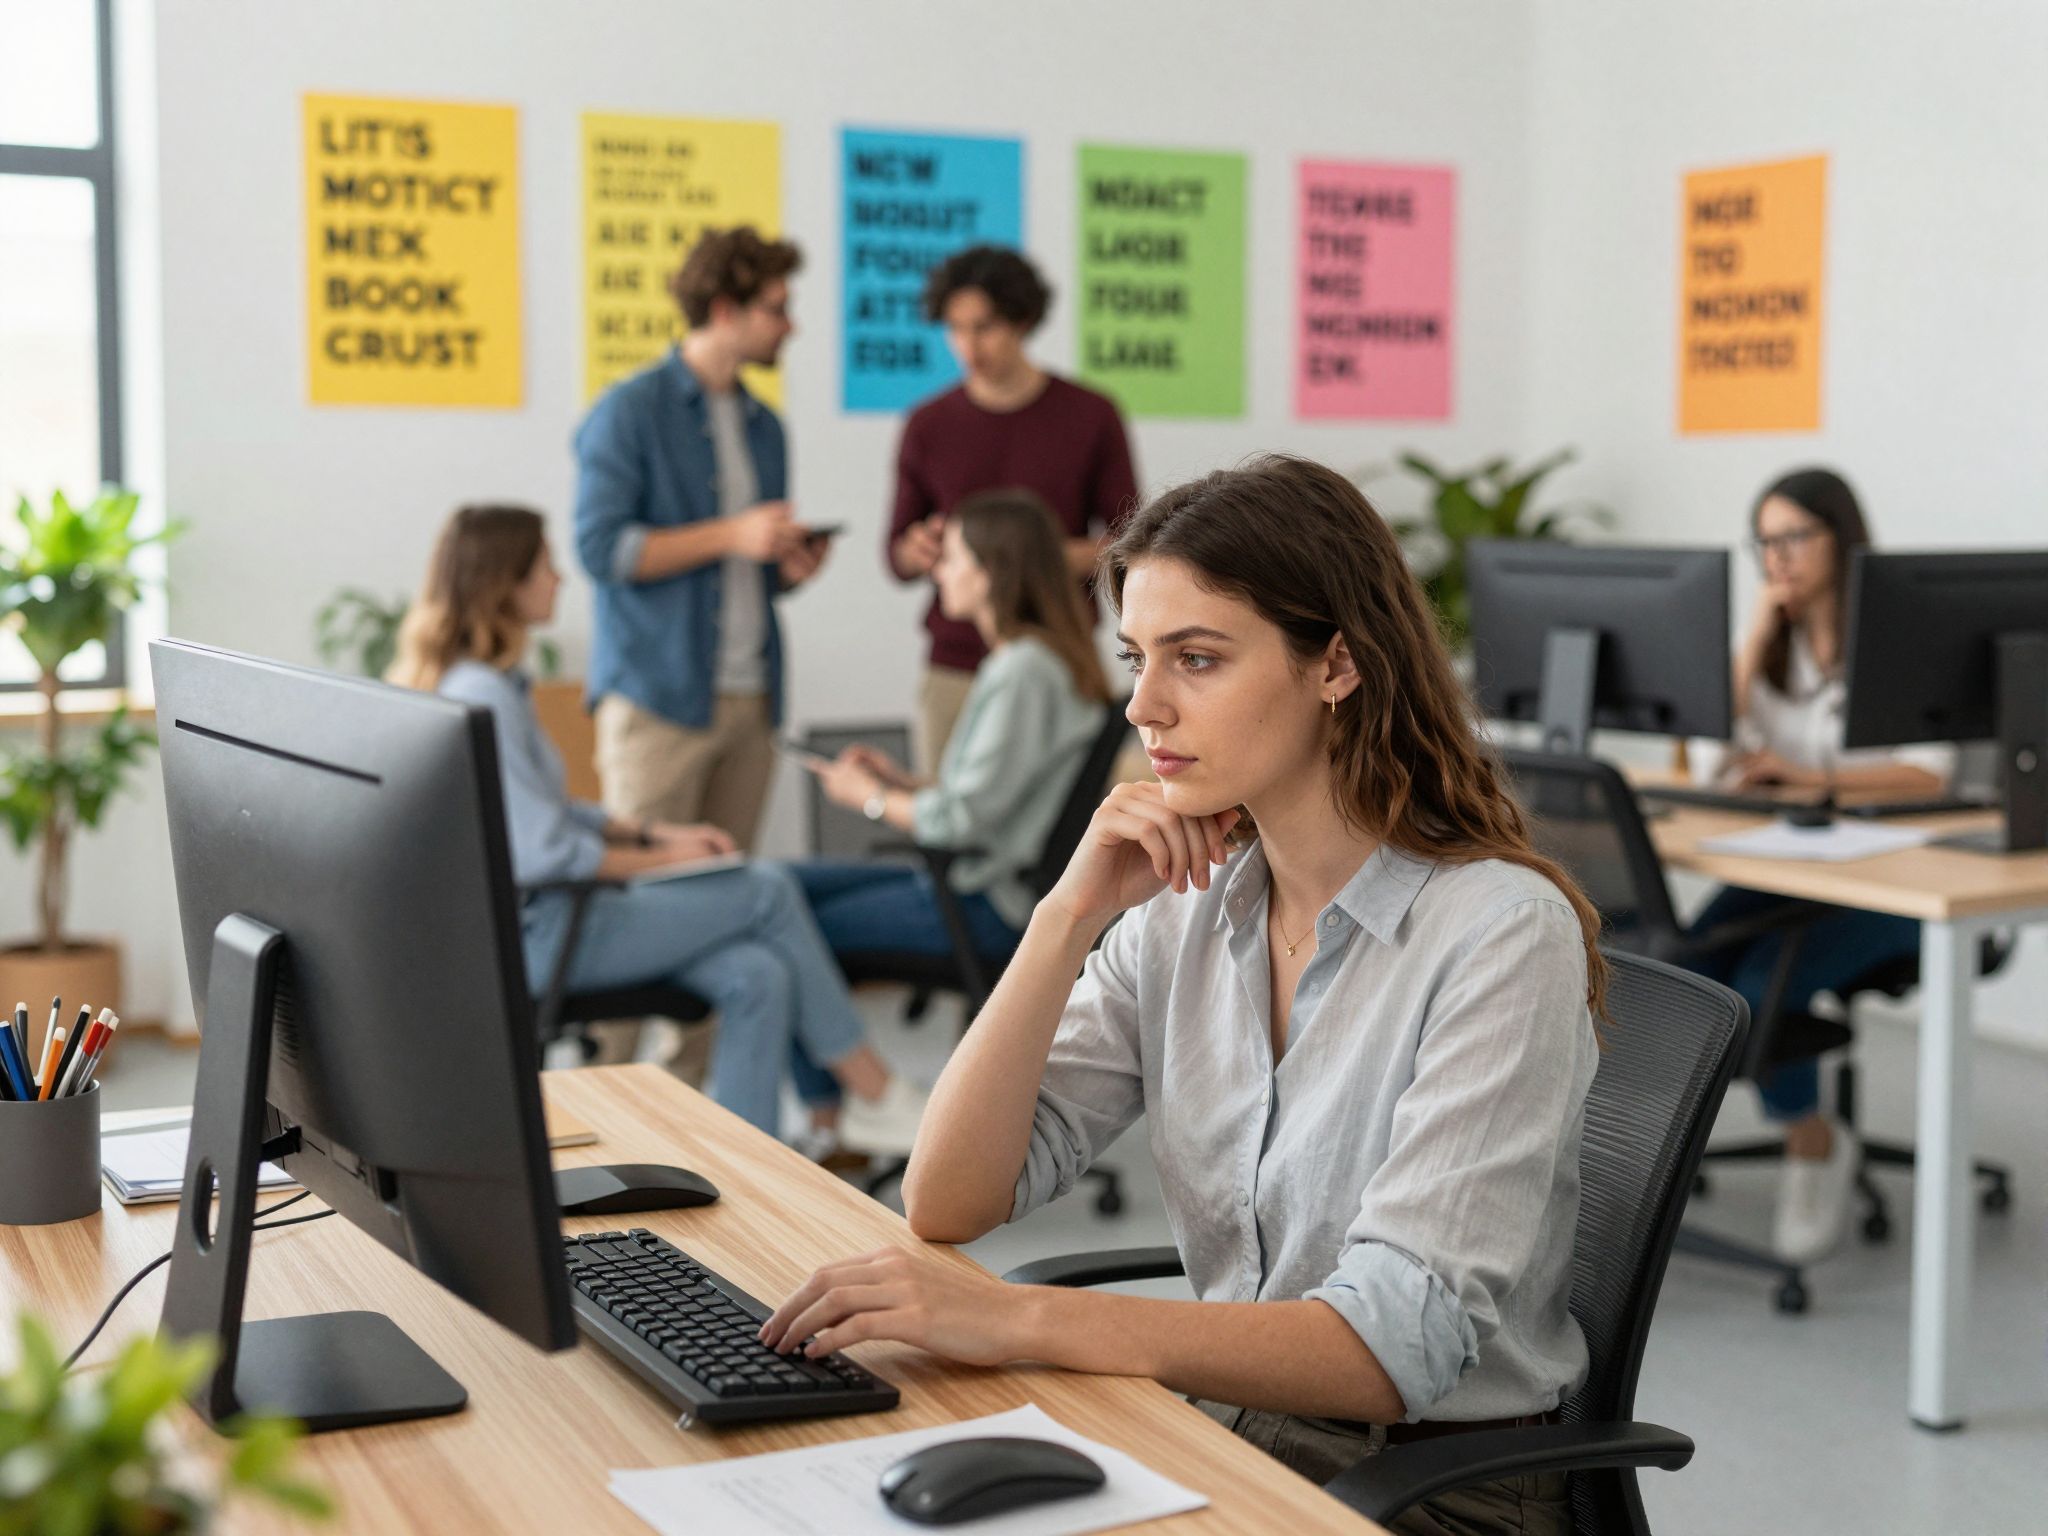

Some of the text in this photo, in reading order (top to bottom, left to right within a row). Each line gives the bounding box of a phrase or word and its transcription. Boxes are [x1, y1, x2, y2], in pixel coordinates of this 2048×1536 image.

[324, 225, 424, 260] MEX
[325, 276, 459, 314] BOOK
[324, 328, 479, 367] CRUST
